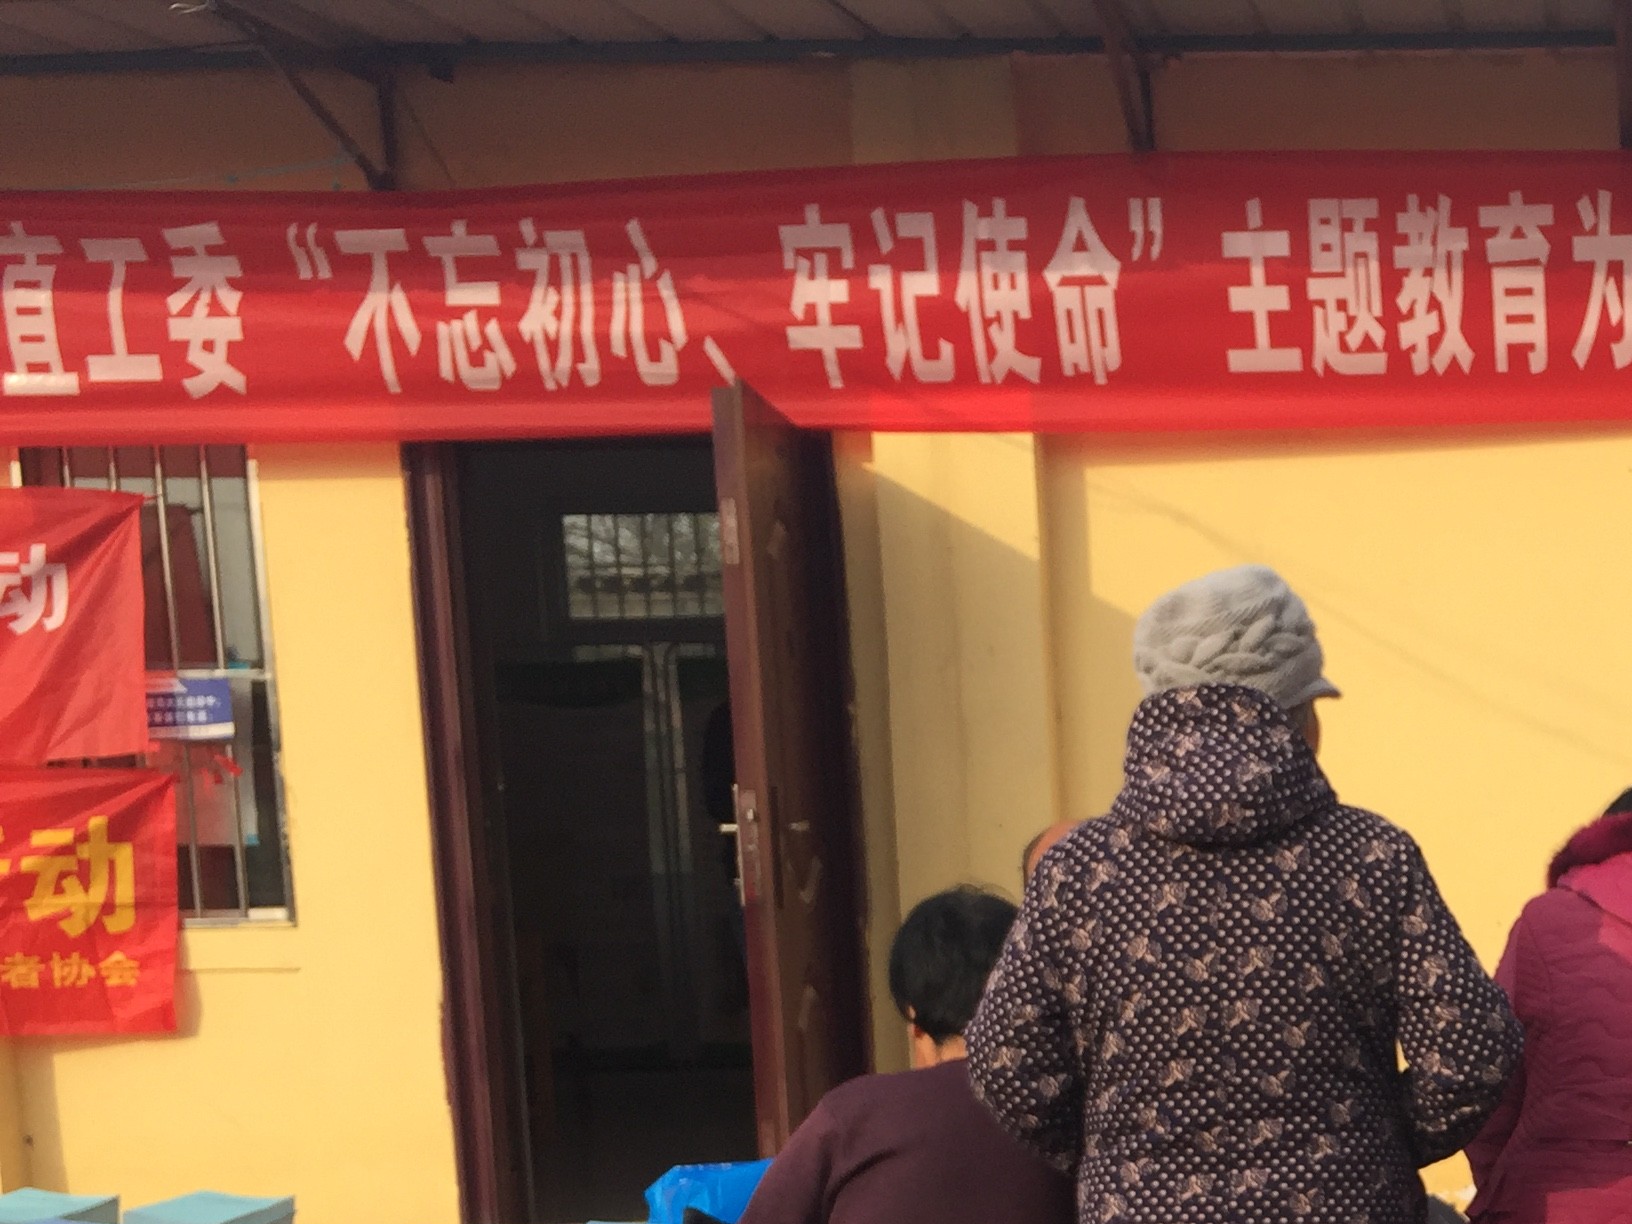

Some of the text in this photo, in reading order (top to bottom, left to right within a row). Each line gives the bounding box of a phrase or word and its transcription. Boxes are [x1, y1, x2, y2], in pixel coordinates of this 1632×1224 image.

[0, 543, 69, 635] 动
[0, 815, 136, 938] 动
[0, 950, 140, 990] 者协会
